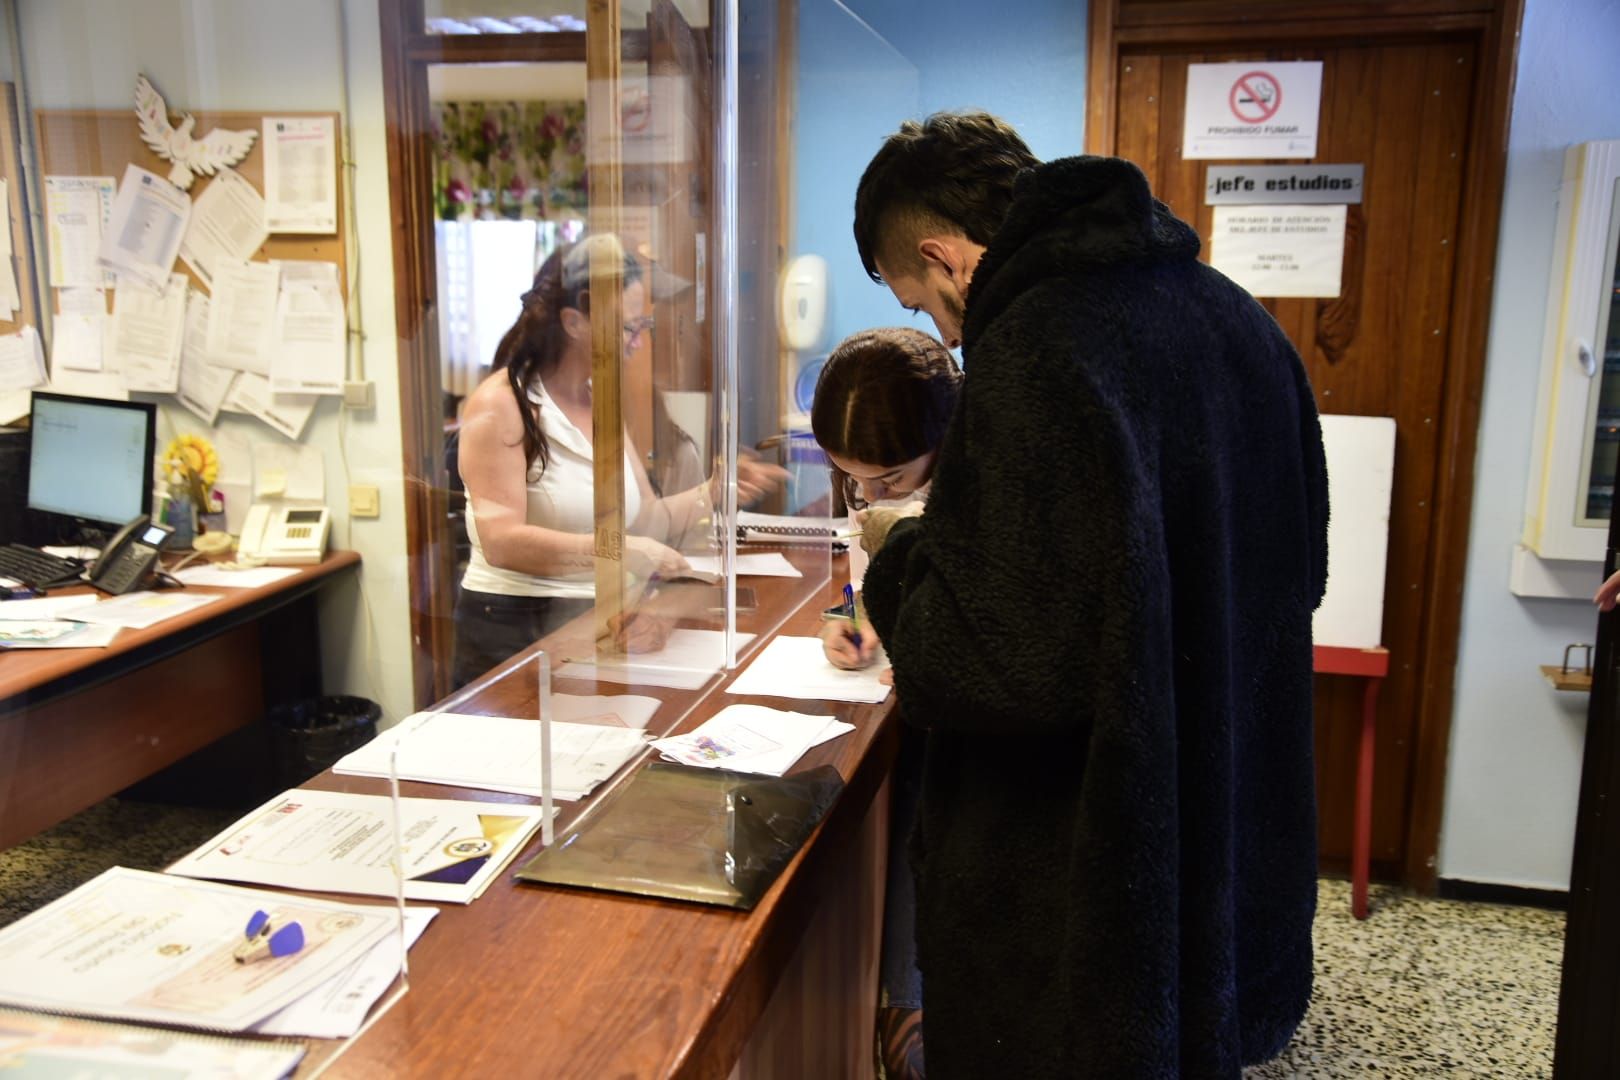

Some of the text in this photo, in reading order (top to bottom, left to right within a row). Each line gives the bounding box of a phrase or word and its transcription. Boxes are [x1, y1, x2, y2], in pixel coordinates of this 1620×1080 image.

[1208, 125, 1298, 135] PROHIBIDO FUMAR
[1215, 175, 1353, 194] jefe estudios
